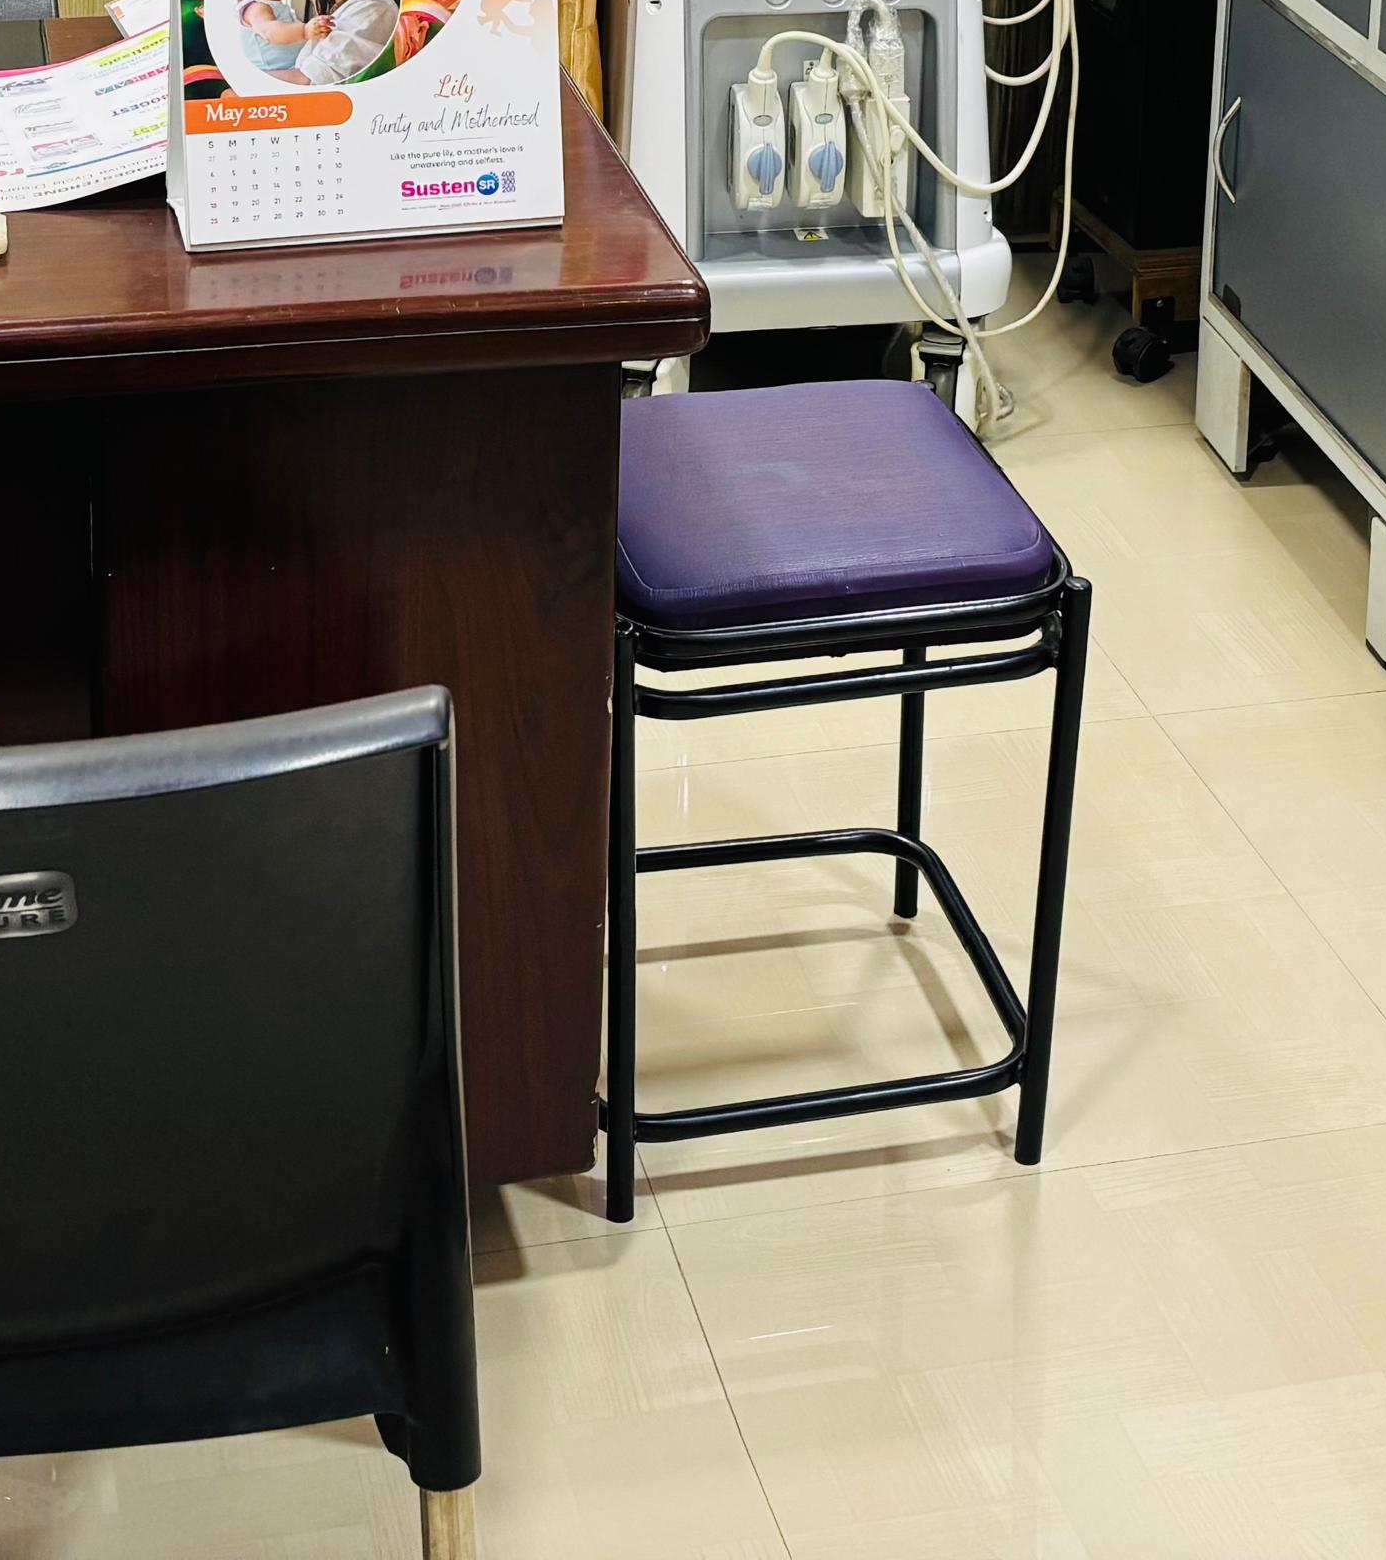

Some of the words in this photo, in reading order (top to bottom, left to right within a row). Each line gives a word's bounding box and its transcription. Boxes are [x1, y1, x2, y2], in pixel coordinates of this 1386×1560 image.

[434, 73, 476, 103] Lily
[205, 104, 244, 127] May
[248, 105, 288, 123] 2025
[370, 112, 412, 144] Purity
[417, 107, 447, 134] and
[451, 101, 541, 131] Motherhood
[251, 138, 256, 146] T
[270, 137, 280, 145] W
[294, 135, 299, 143] T
[390, 152, 406, 161] Like
[407, 151, 421, 159] the
[422, 151, 441, 160] pure
[464, 147, 498, 155] mother's
[457, 158, 473, 166] and
[401, 180, 476, 198] Susten
[478, 180, 496, 190] SR
[501, 185, 517, 193] 200
